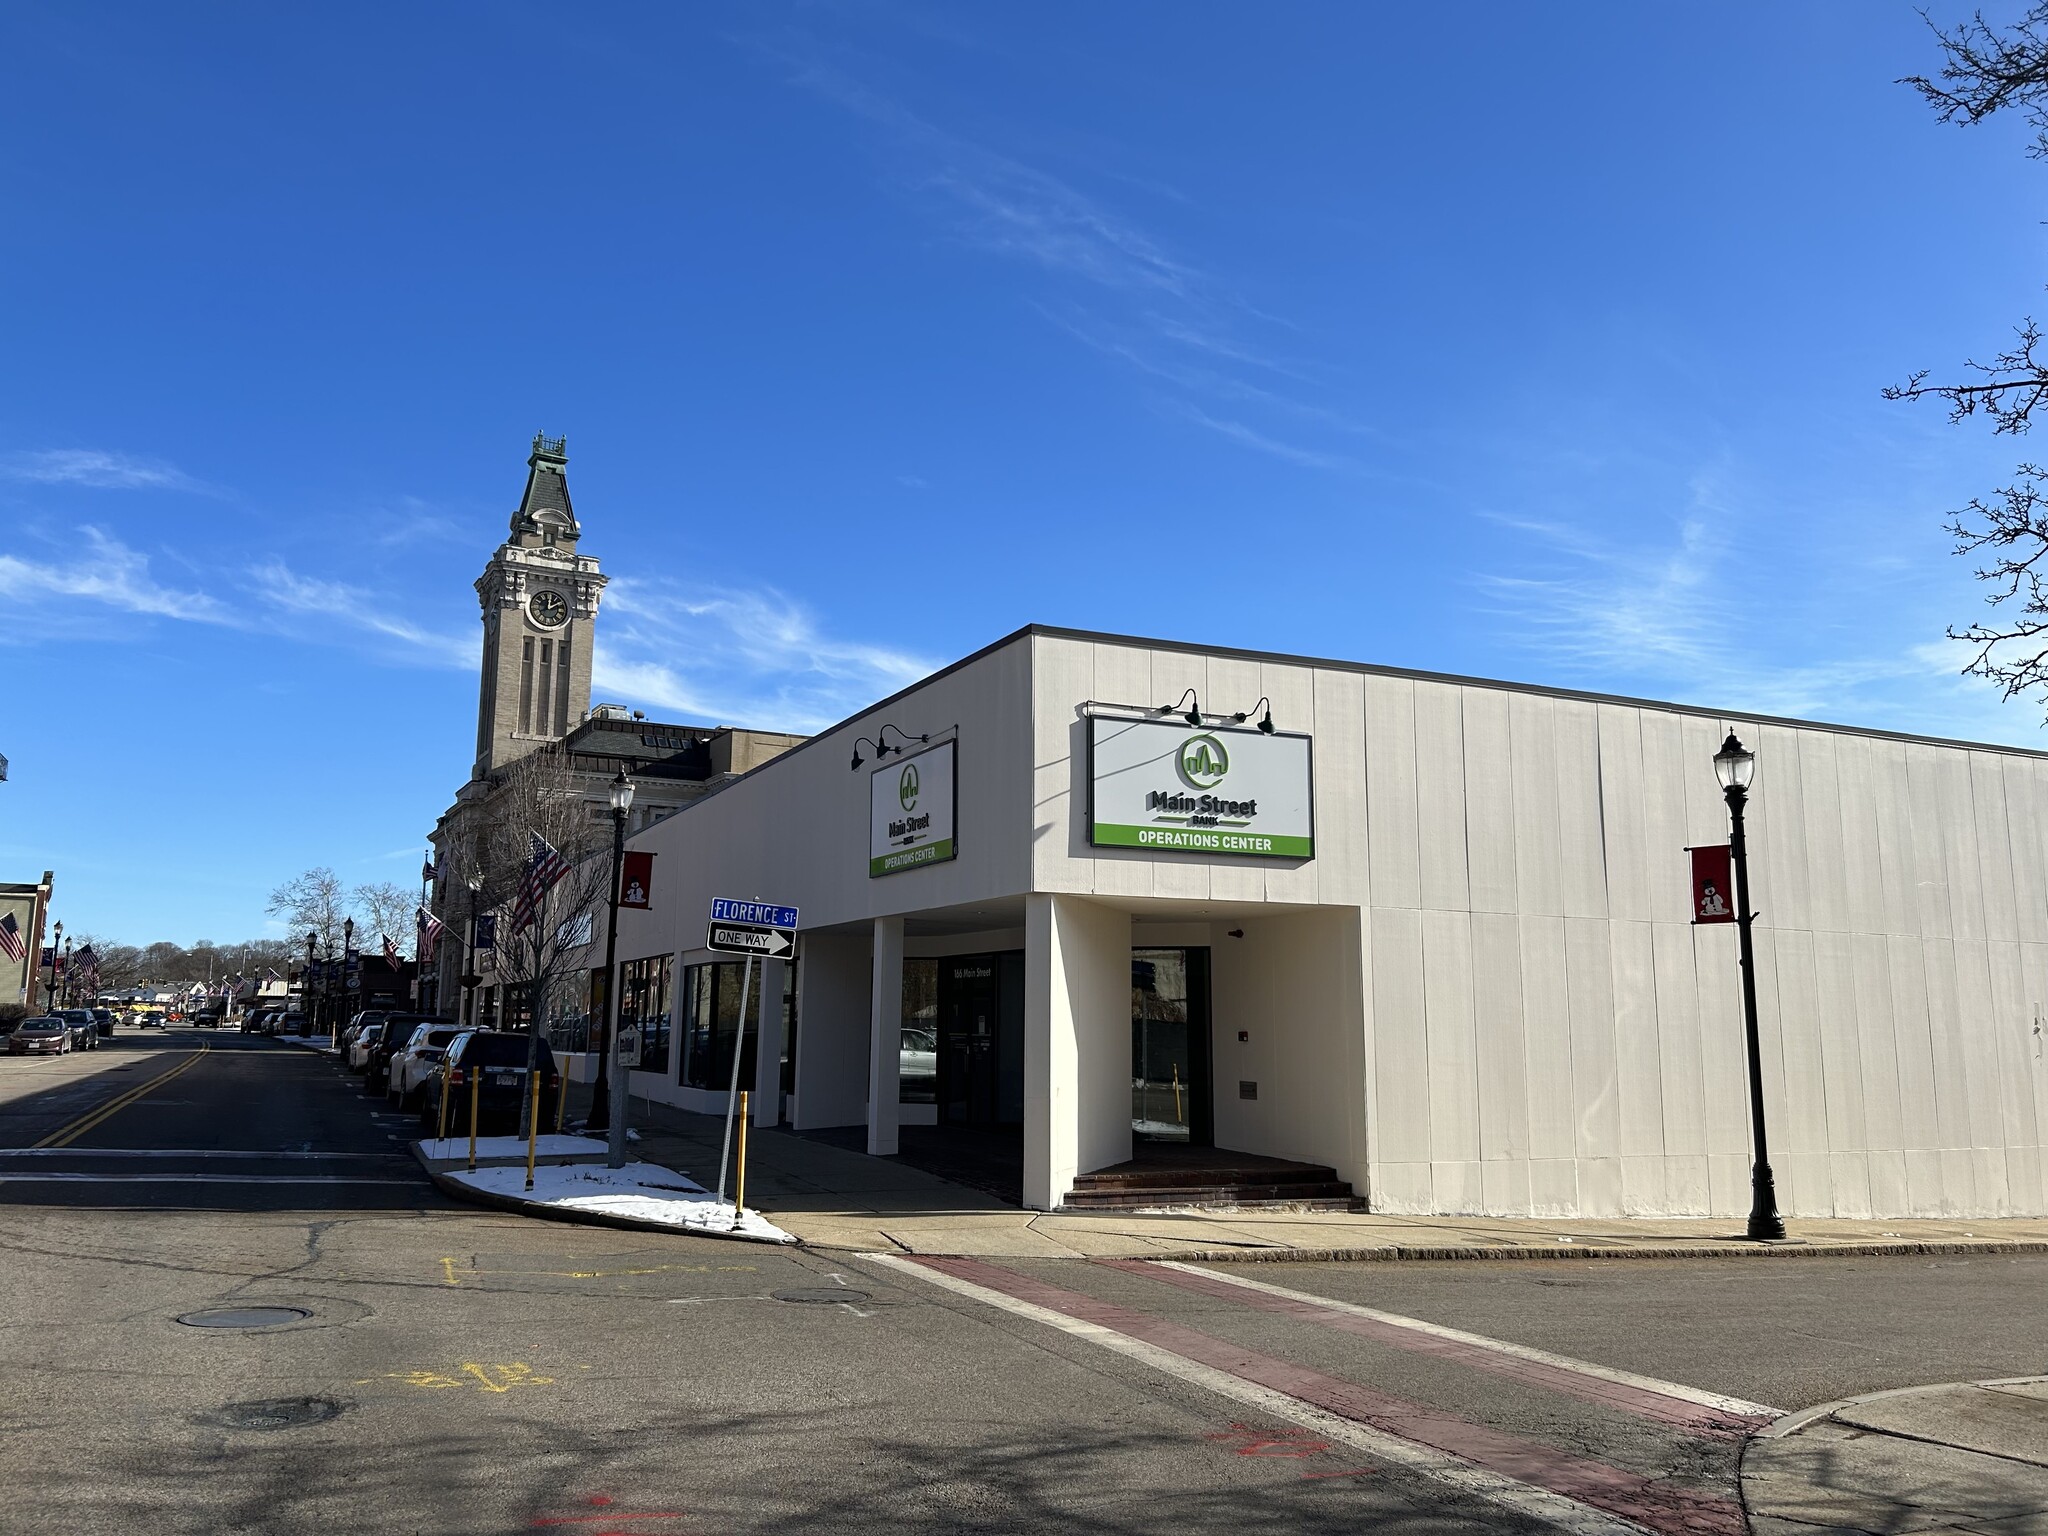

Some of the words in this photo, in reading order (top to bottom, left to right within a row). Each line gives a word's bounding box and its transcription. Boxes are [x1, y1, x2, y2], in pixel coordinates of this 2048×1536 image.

[1151, 790, 1196, 811] Main
[1200, 794, 1258, 816] Street
[888, 819, 906, 838] Main
[906, 813, 929, 833] Street
[1192, 815, 1219, 826] BANK
[1138, 830, 1220, 848] OPERATIONS
[1222, 835, 1272, 851] CENTER
[884, 851, 914, 869] OPERATIONS
[915, 847, 935, 862] CENTER
[715, 901, 779, 924] FLORENCE
[784, 912, 794, 923] ST
[718, 931, 741, 943] ONE
[745, 933, 769, 947] WAY
[963, 968, 976, 978] Main
[976, 968, 991, 977] Street
